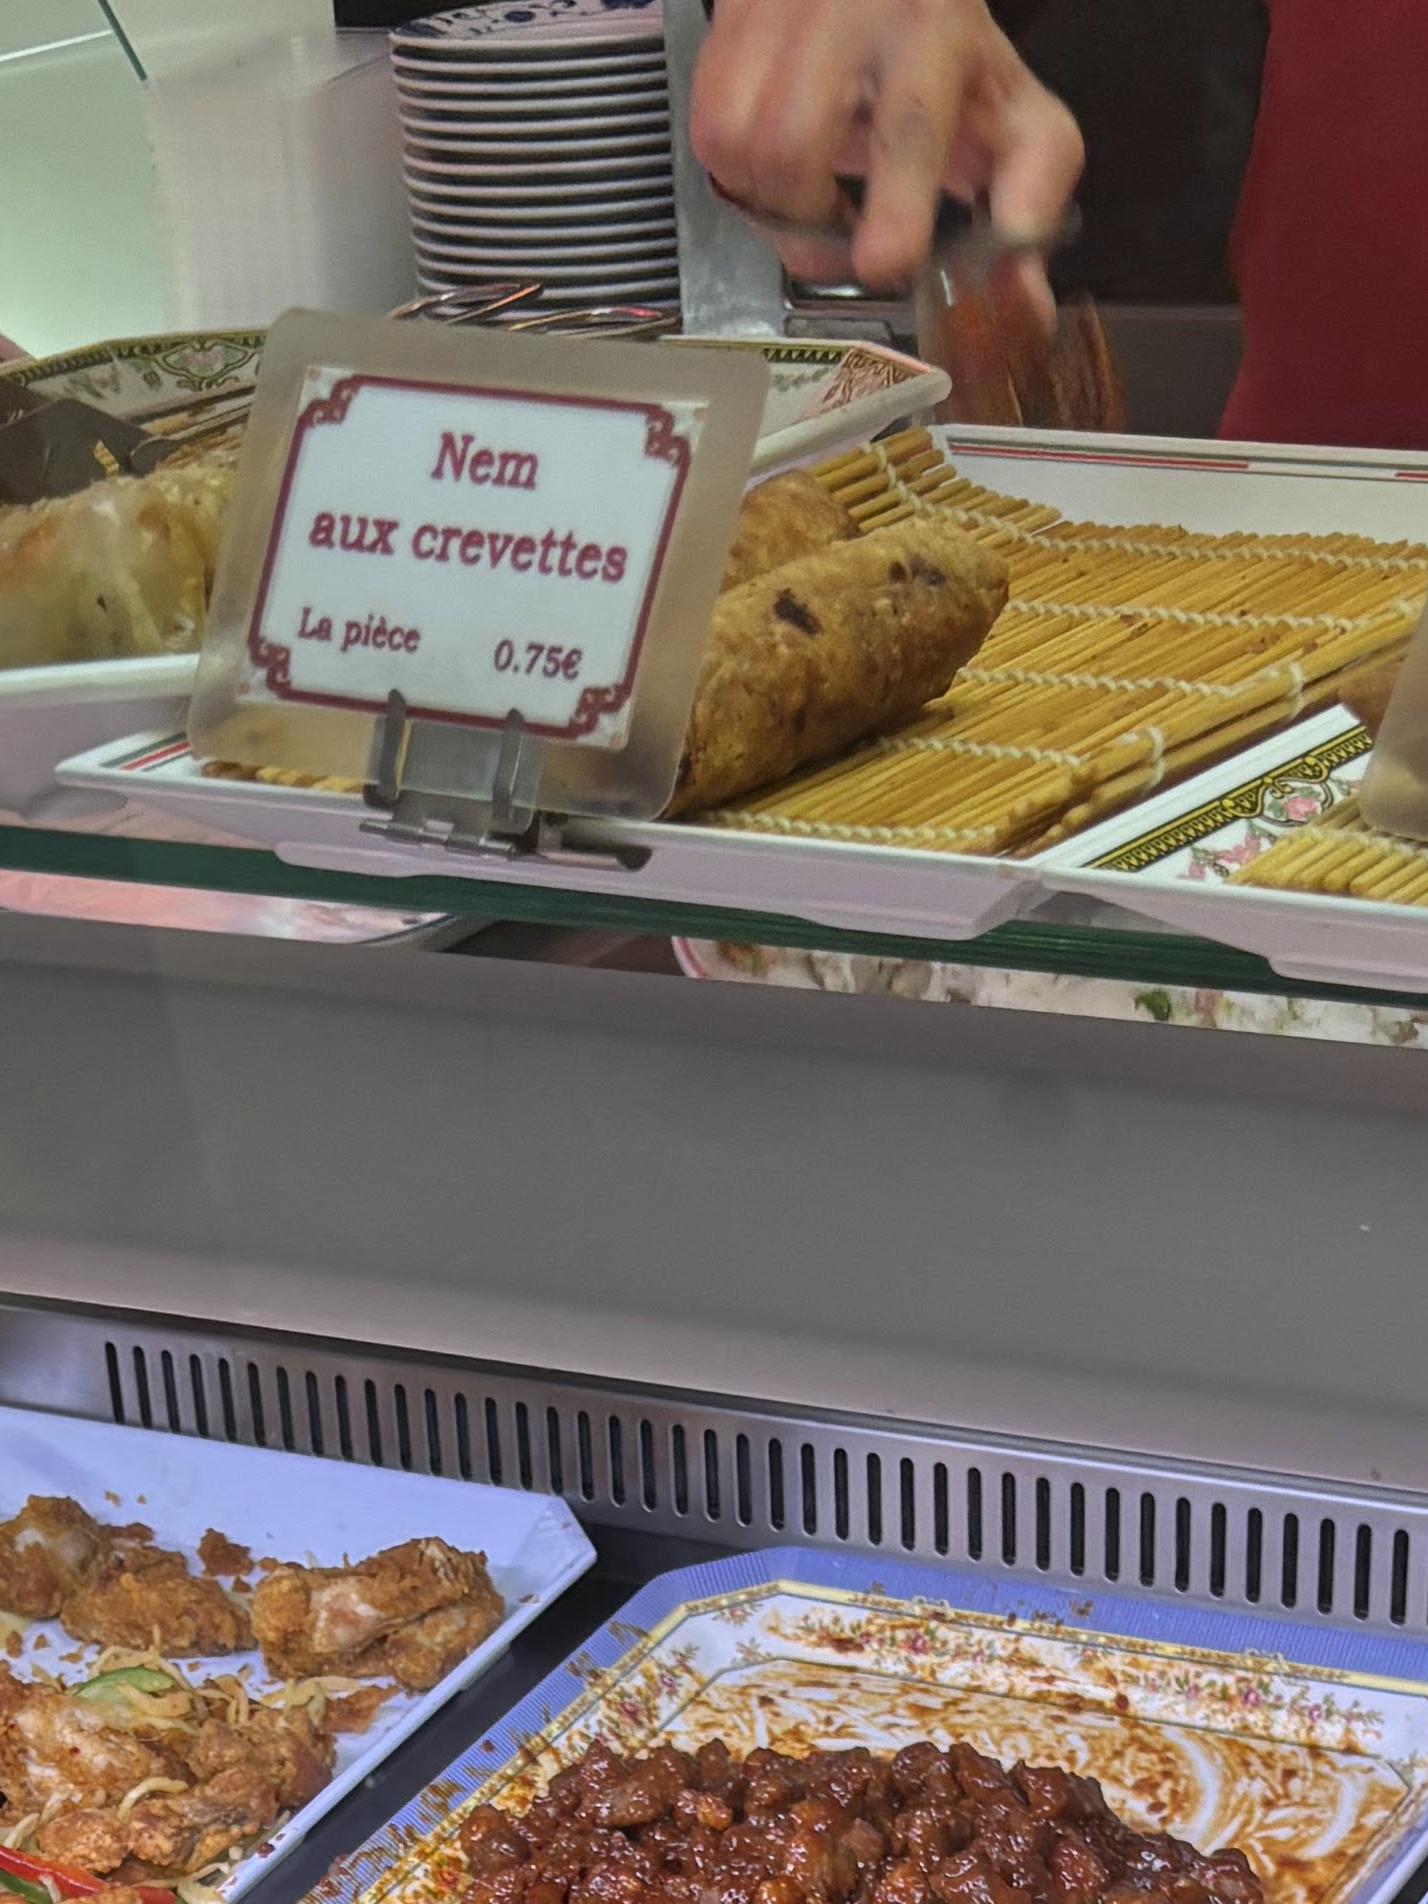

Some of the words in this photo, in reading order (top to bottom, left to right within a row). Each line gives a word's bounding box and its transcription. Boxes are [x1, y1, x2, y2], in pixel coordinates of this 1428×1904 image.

[430, 430, 539, 491] Nem
[309, 510, 399, 555] aux
[411, 522, 628, 584] crevettes
[298, 607, 332, 641] La
[341, 613, 421, 654] pièce
[493, 638, 582, 681] 0.75€
